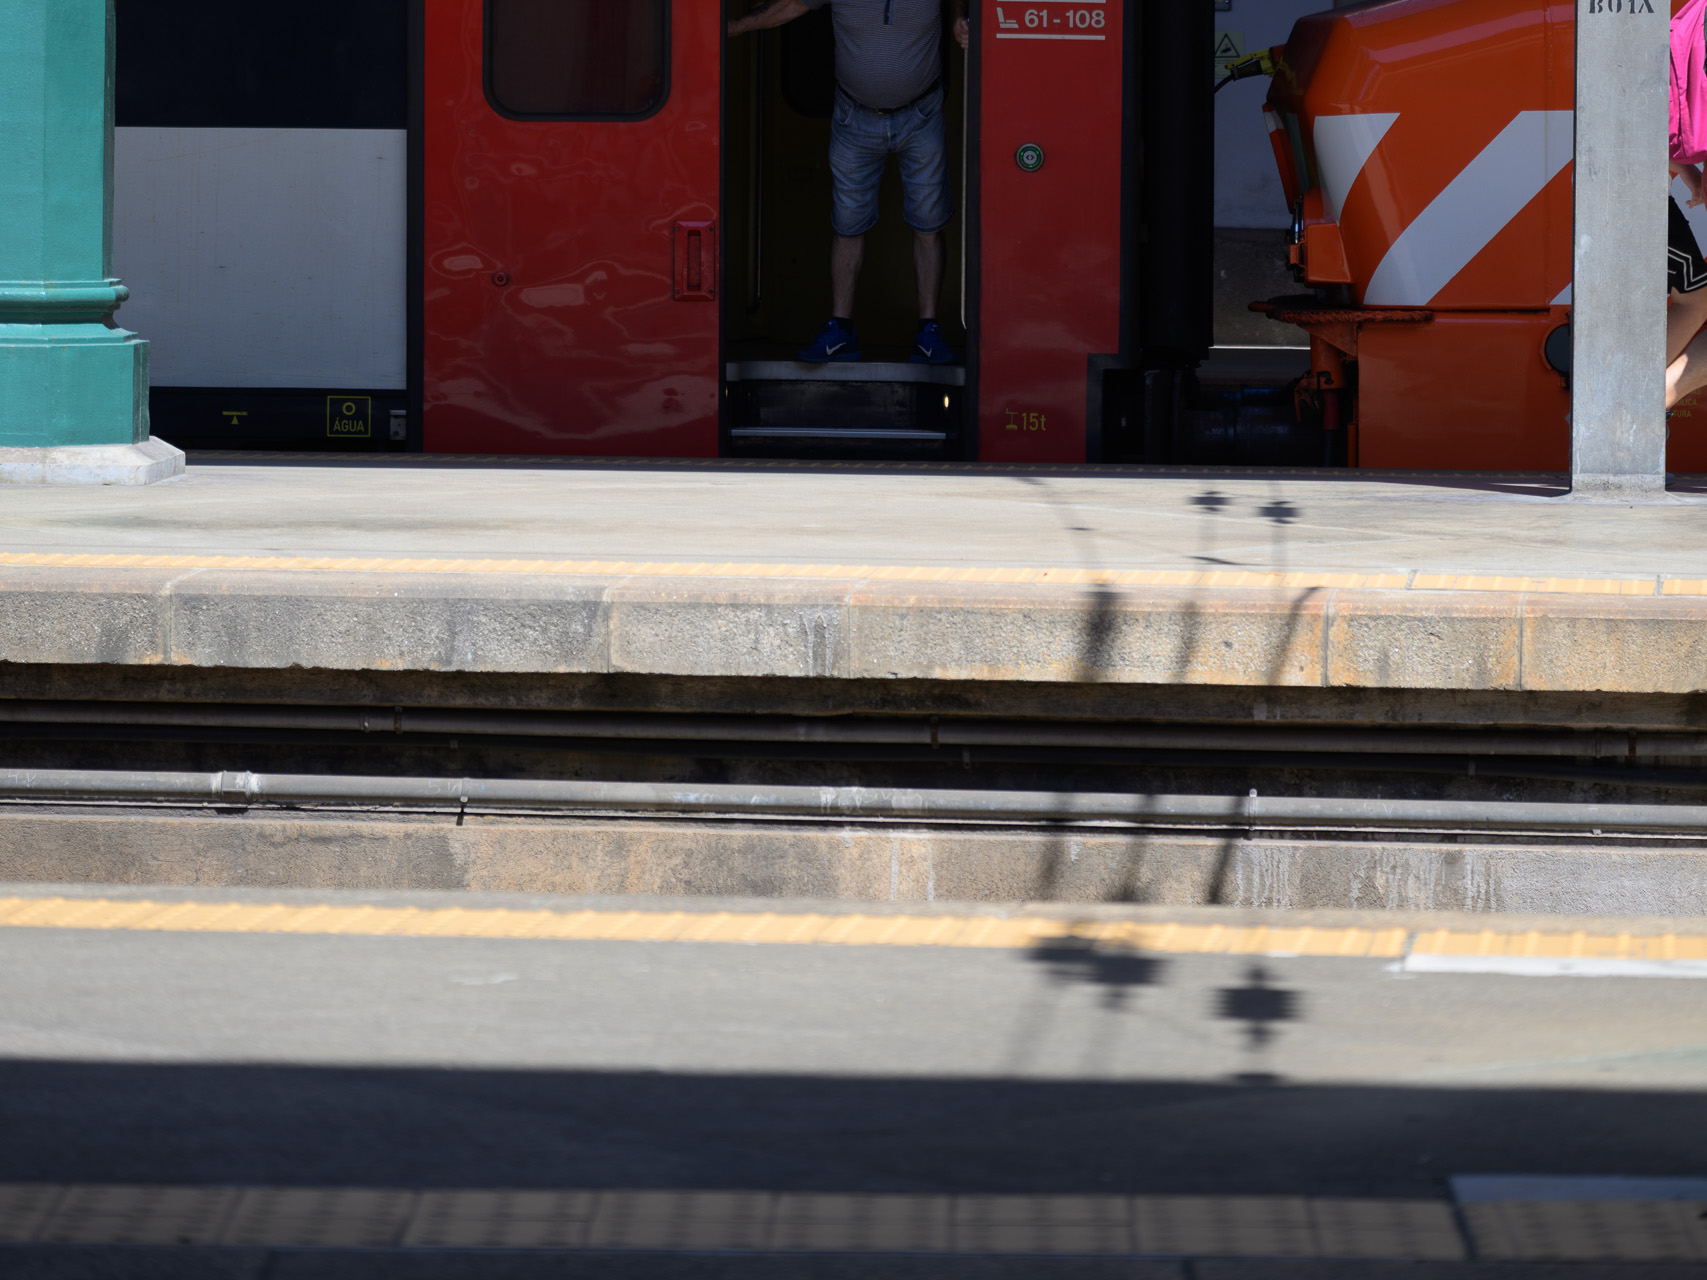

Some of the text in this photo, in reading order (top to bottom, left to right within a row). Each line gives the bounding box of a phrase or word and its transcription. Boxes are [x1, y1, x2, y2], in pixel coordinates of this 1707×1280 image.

[1024, 8, 1048, 28] 61
[1065, 9, 1106, 29] 108
[332, 416, 365, 432] ÁGUA
[1021, 412, 1047, 432] 15t
